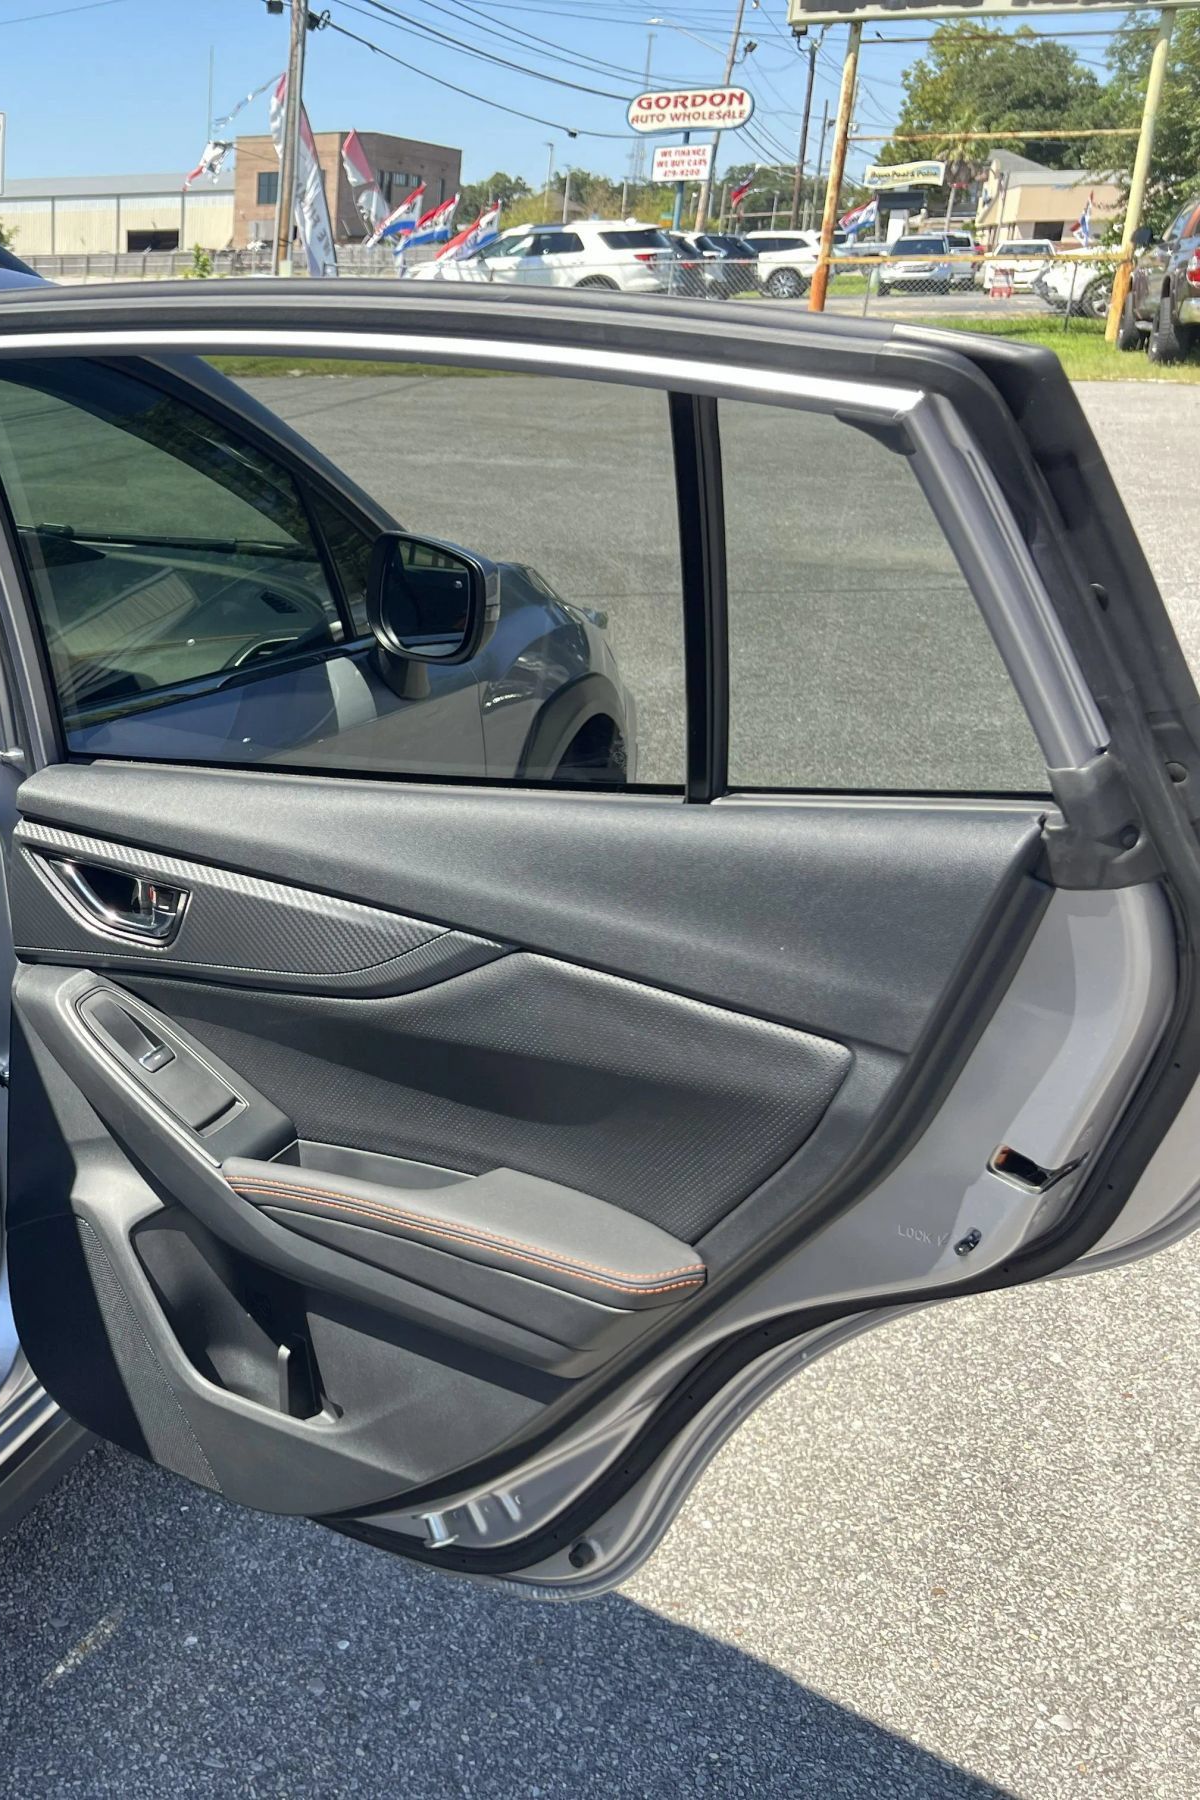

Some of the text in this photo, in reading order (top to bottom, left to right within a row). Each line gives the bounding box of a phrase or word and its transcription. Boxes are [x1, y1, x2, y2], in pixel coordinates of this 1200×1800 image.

[637, 92, 745, 110] GORDON
[631, 110, 746, 125] AUTO WHOLESALE
[660, 148, 706, 158] WE FINANCE
[656, 158, 707, 168] WE BUY CARS
